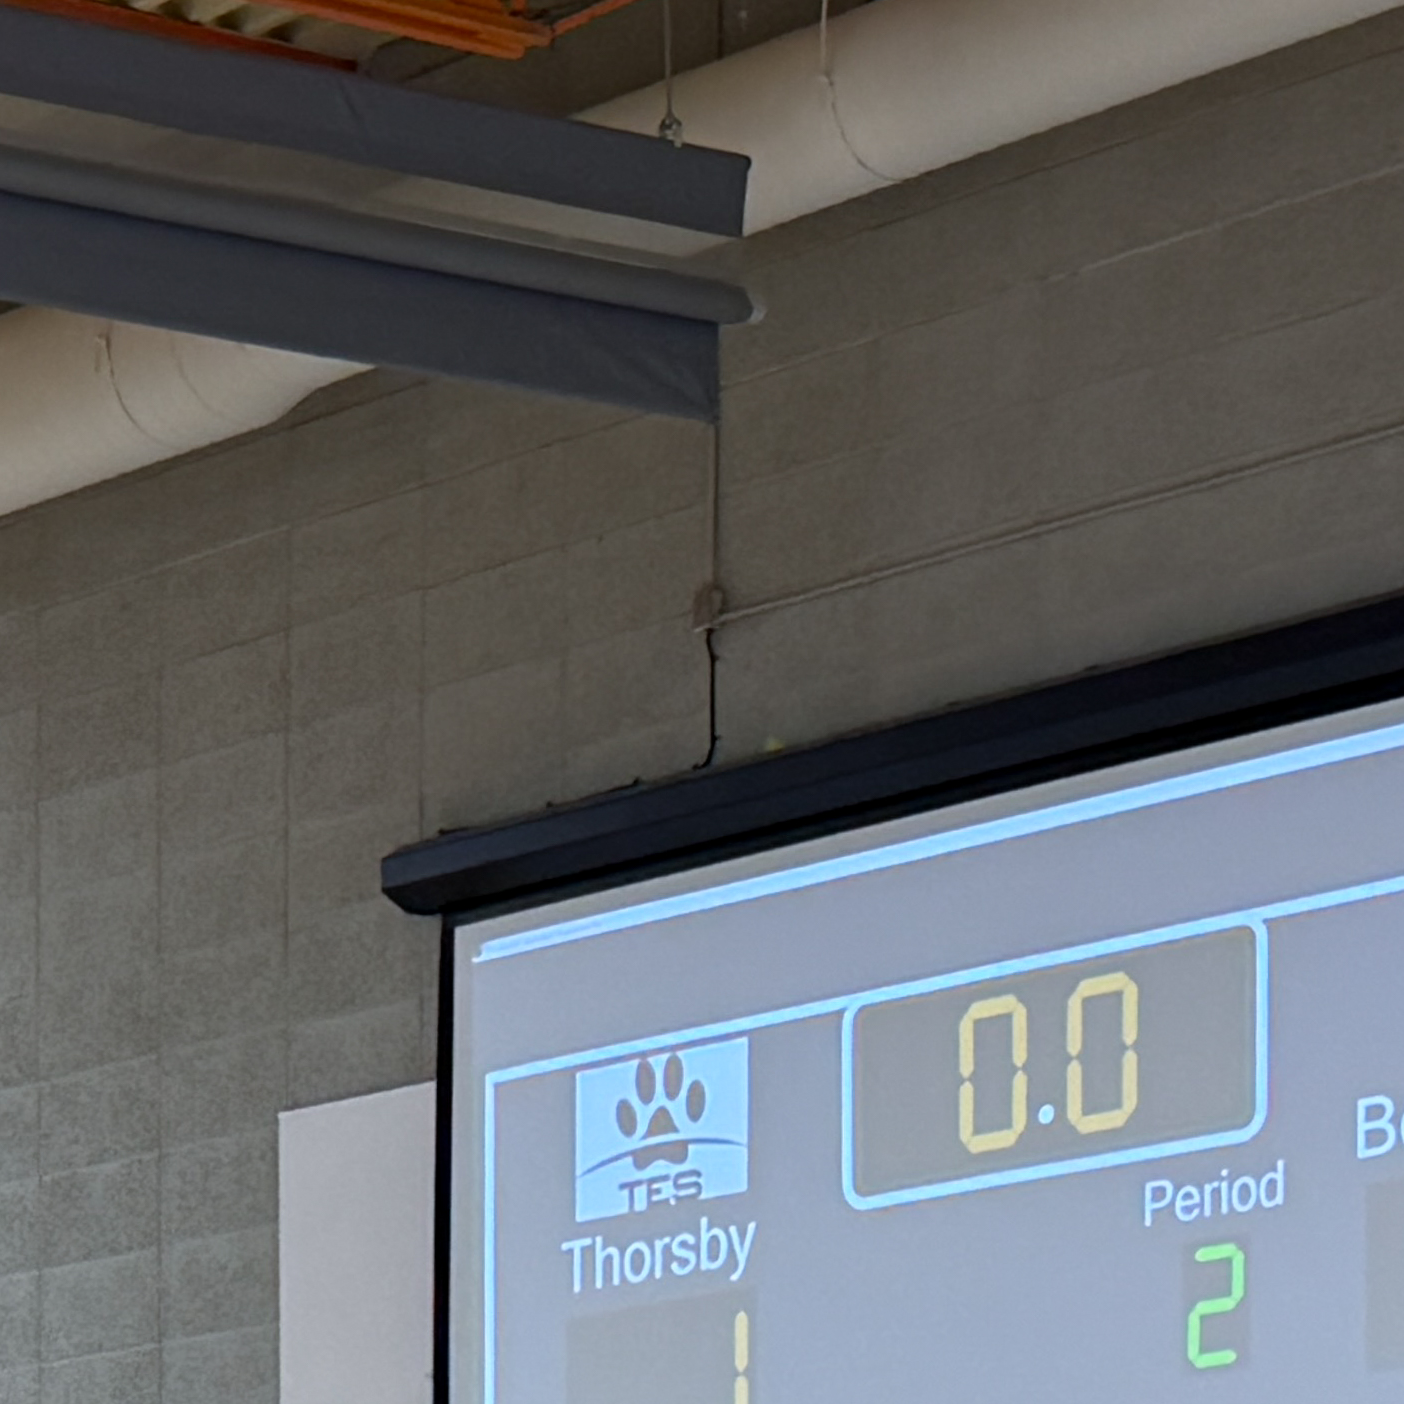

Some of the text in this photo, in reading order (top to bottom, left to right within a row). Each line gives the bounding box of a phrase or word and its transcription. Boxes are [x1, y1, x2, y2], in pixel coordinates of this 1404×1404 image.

[959, 971, 1138, 1154] 0.0
[1356, 1095, 1404, 1160] B
[1143, 1159, 1286, 1227] Period
[560, 1216, 757, 1293] Thorsby
[1187, 1243, 1245, 1369] 2
